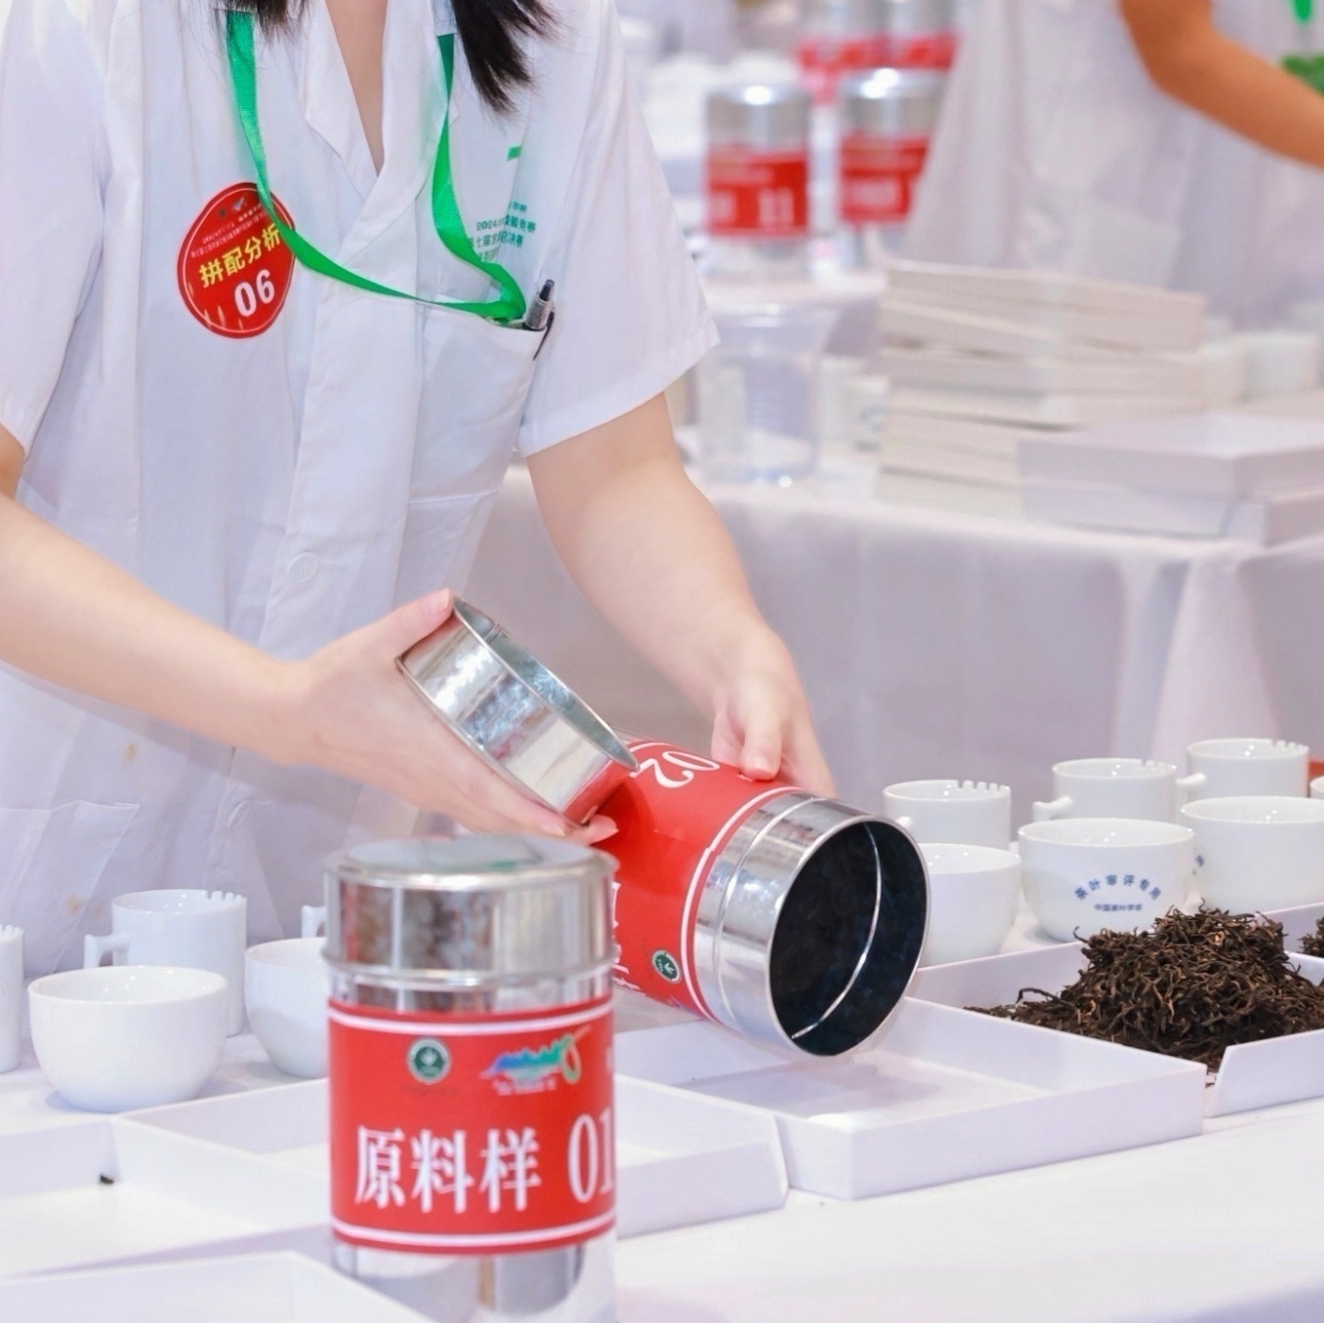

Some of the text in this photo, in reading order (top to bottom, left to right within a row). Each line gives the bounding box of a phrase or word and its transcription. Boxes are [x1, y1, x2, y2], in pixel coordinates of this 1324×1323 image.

[199, 223, 282, 289] 拼配分析
[233, 268, 276, 317] 06
[354, 1112, 613, 1215] 原料样 01
